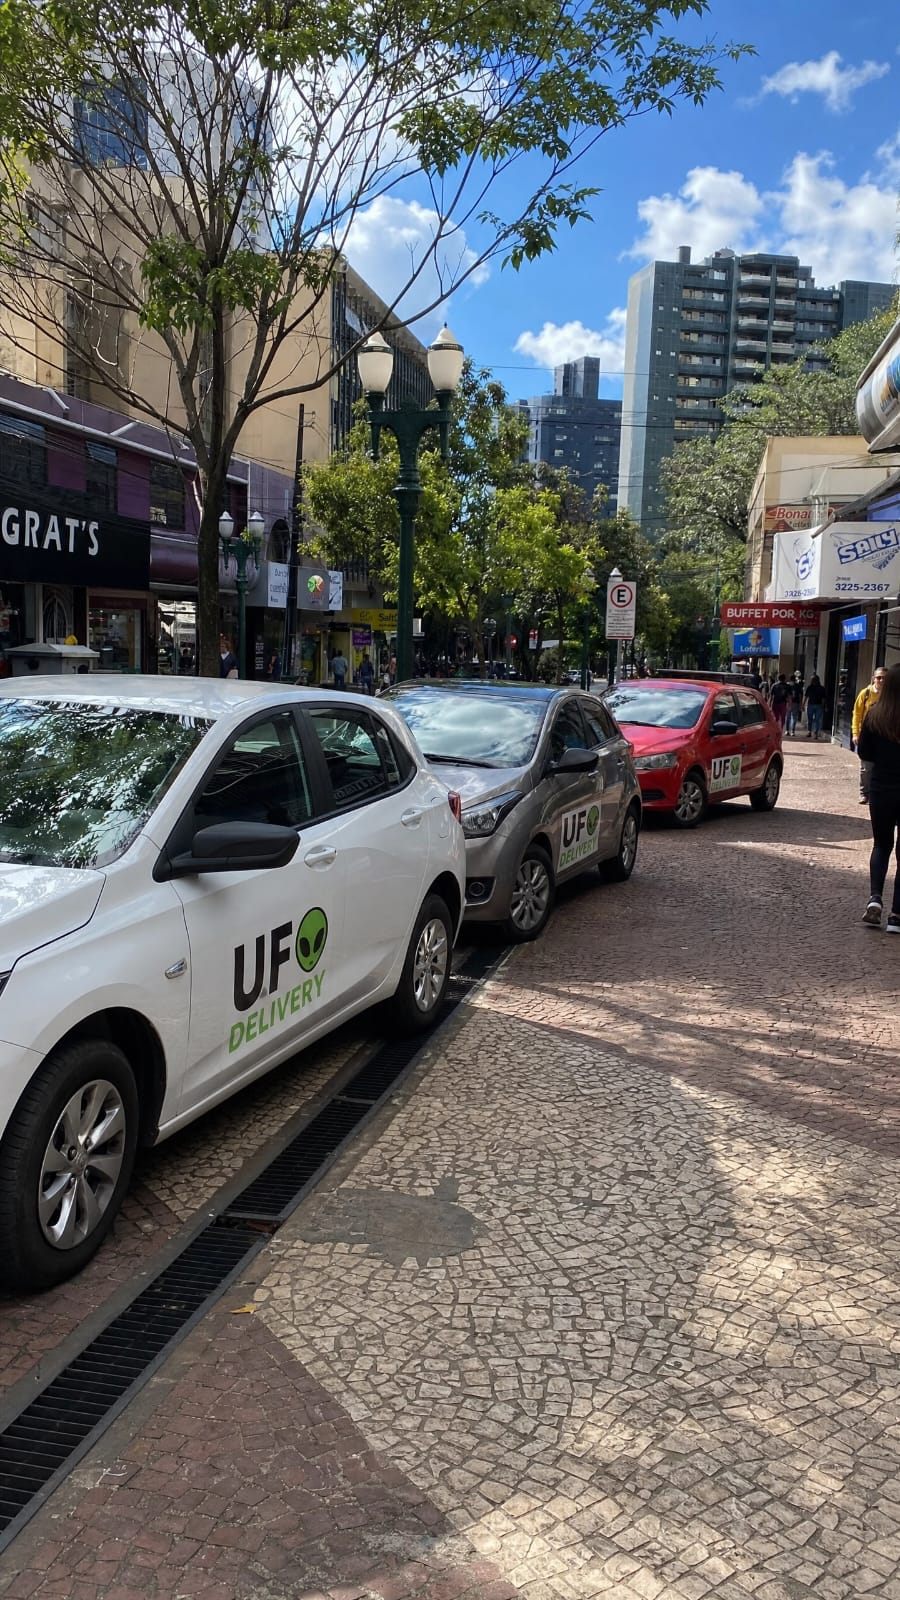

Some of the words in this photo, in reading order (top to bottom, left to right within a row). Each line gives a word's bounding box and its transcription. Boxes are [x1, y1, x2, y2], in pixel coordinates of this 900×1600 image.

[2, 506, 99, 556] GRAT'S
[838, 529, 898, 563] SAILY
[835, 583, 890, 592] 3225-2367
[617, 589, 626, 603] E
[727, 607, 768, 618] BUFFET
[771, 608, 795, 618] POR
[799, 608, 814, 618] KG
[740, 644, 769, 653] Loterias
[710, 776, 739, 791] DELIVERY
[559, 836, 597, 867] DELIVERY
[228, 968, 326, 1054] DELIVERY
